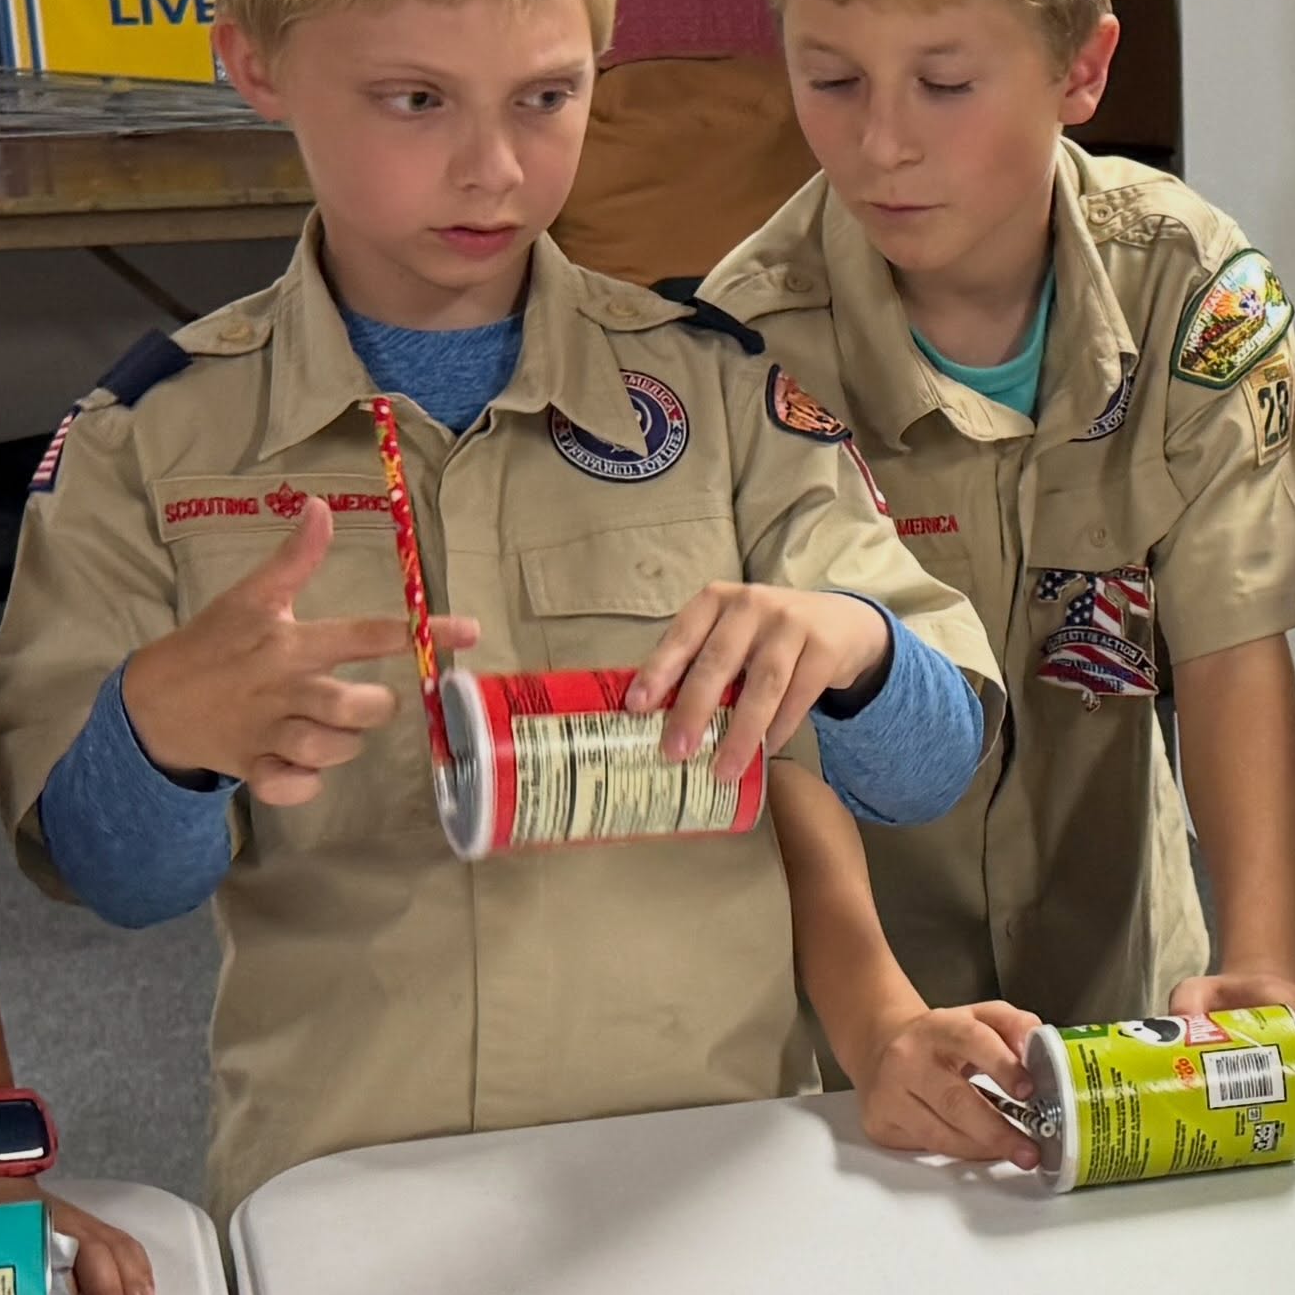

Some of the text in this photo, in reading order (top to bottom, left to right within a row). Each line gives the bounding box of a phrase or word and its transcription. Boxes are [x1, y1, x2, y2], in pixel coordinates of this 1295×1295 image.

[638, 456, 667, 475] FOR
[163, 493, 392, 523] SCOUTING MERIC
[896, 513, 960, 538] MERICA
